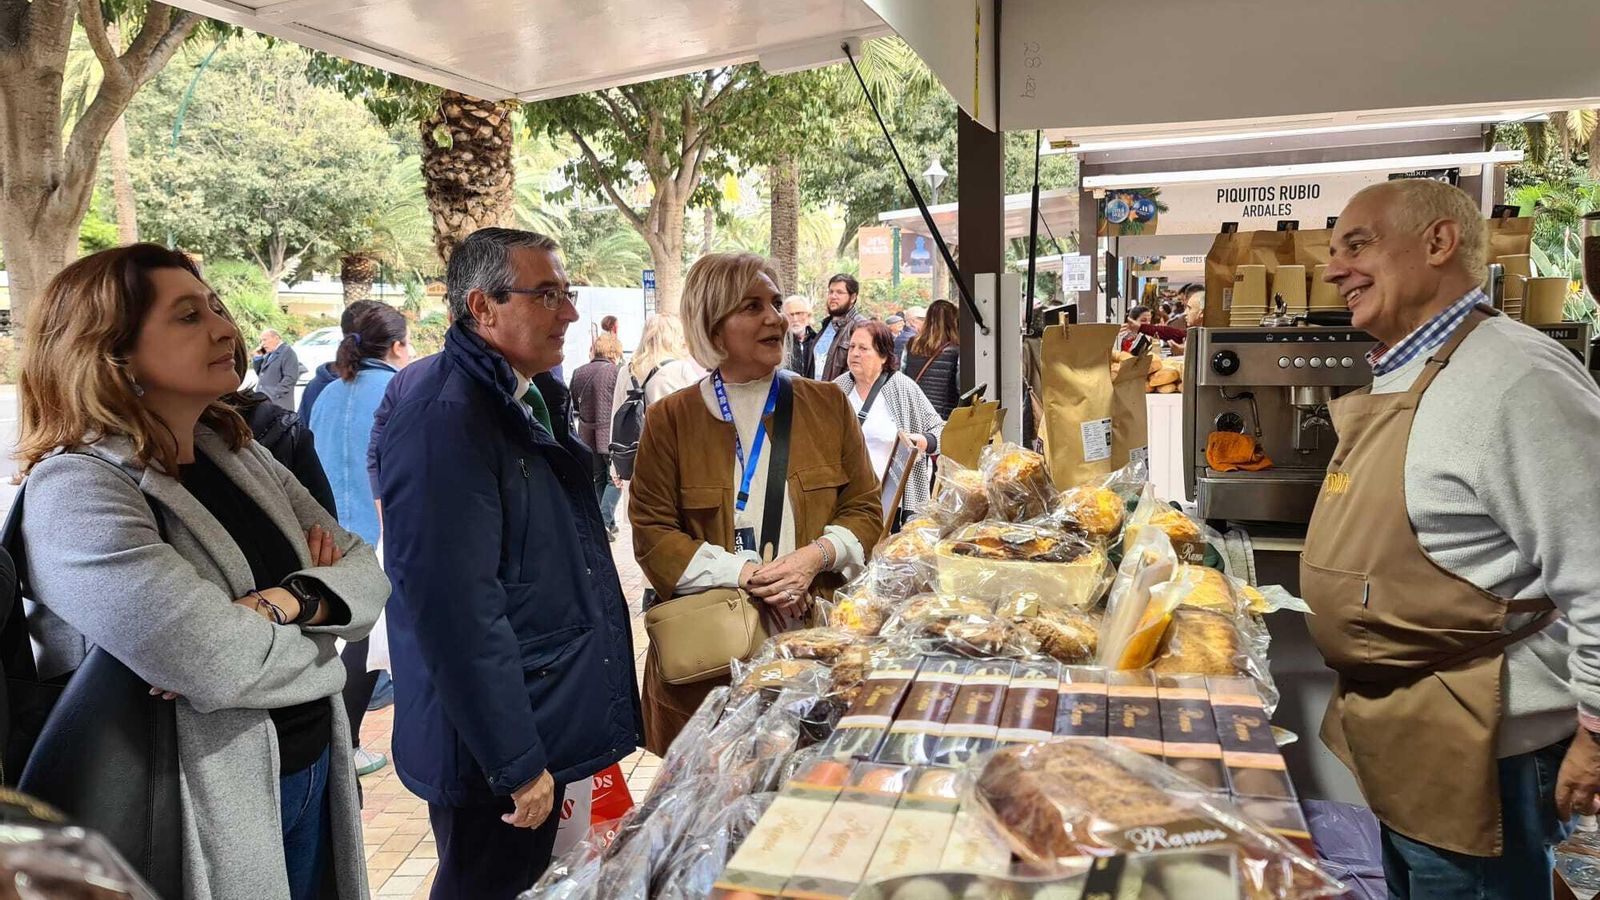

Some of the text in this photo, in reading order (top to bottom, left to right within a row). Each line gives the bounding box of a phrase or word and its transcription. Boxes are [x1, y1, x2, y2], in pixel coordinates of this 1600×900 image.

[1217, 183, 1321, 204] PIQUITOS RUBIO
[1242, 203, 1292, 218] ARDALES
[1124, 826, 1228, 853] Ramos
